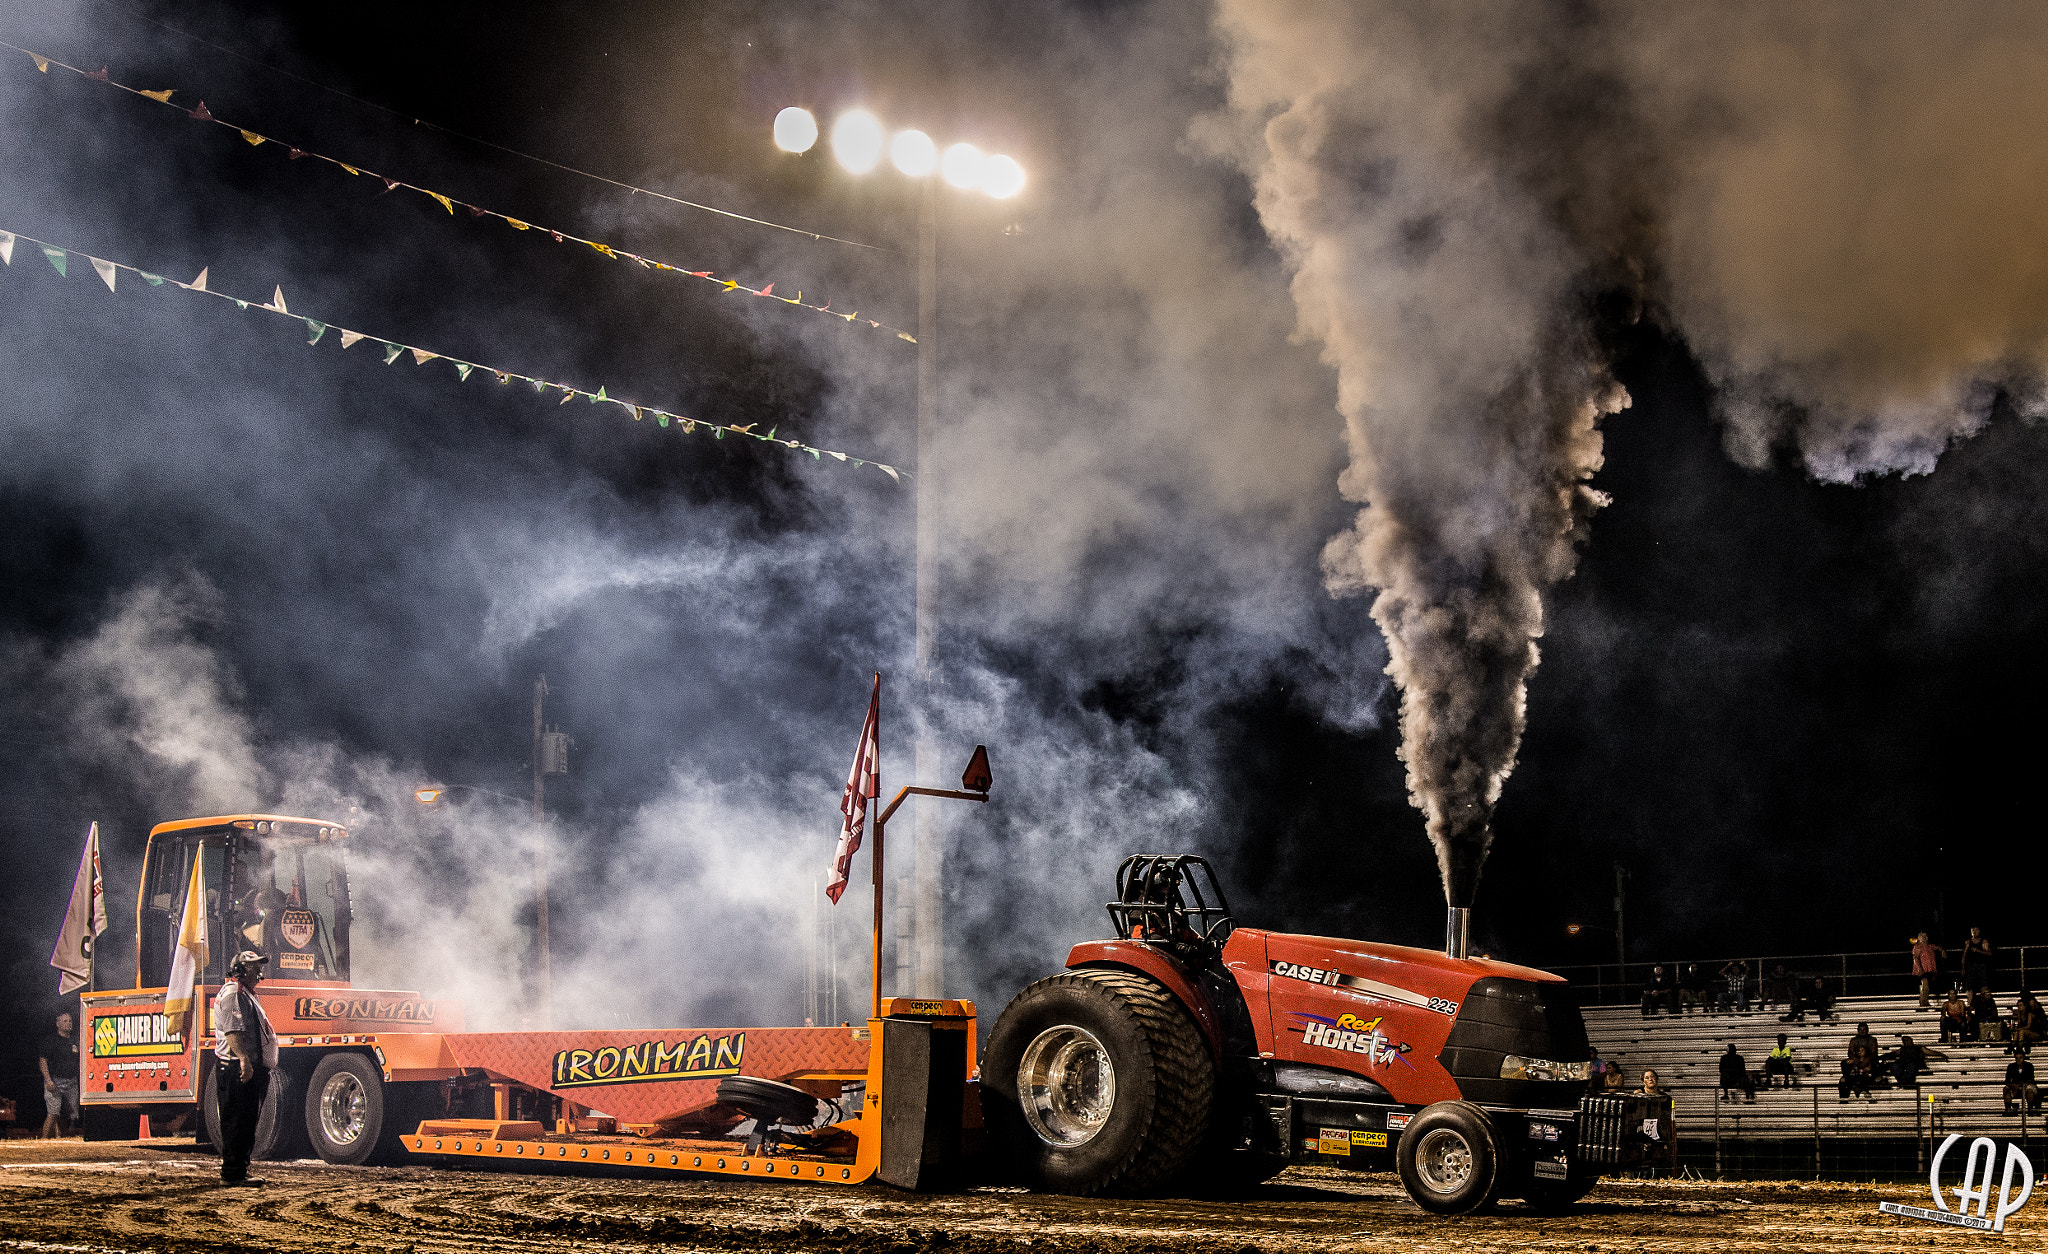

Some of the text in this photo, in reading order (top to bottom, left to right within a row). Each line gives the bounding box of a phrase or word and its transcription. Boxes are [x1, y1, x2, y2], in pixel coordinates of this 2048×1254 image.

[1275, 961, 1323, 984] CASE
[295, 997, 436, 1020] IRONMAN
[1427, 997, 1459, 1015] 225
[118, 1015, 151, 1044] BAUER
[1336, 1013, 1383, 1034] Red
[1302, 1021, 1389, 1057] HORSE
[552, 1032, 746, 1083] IRONMAN
